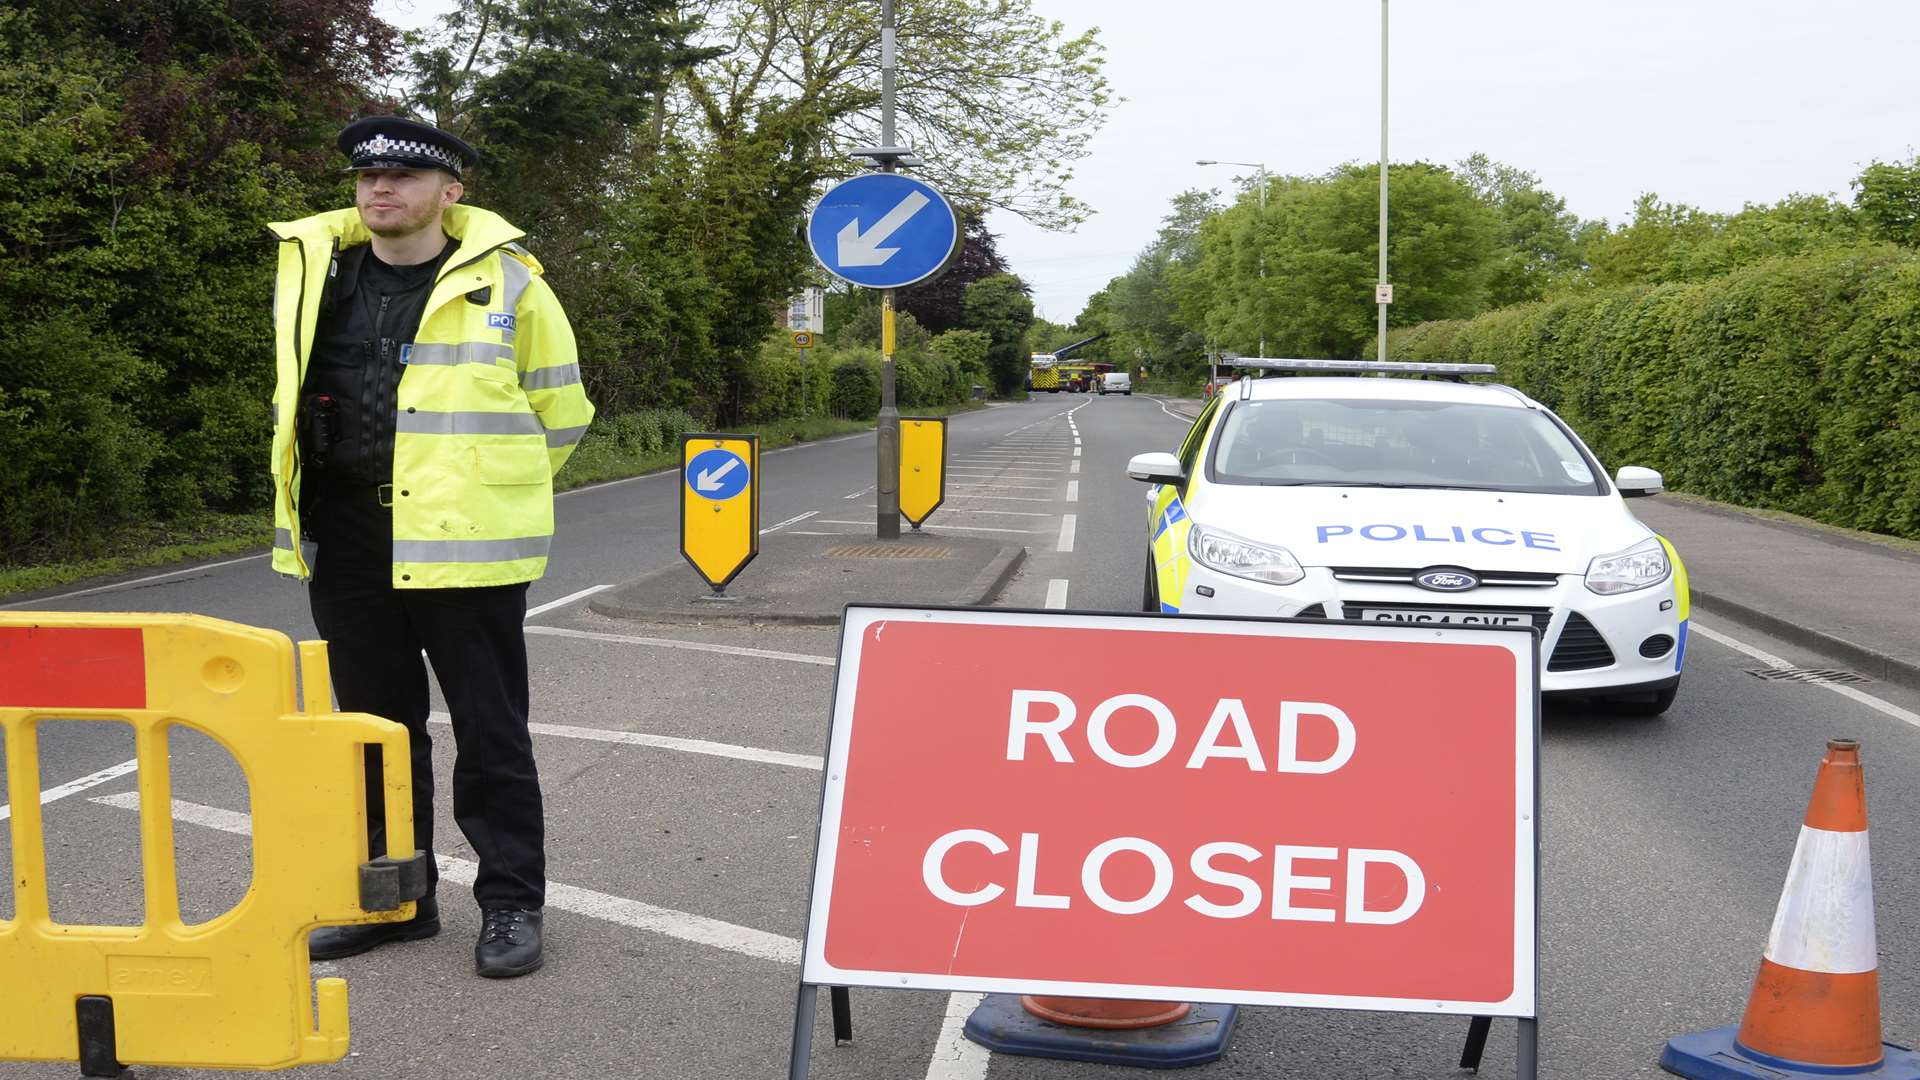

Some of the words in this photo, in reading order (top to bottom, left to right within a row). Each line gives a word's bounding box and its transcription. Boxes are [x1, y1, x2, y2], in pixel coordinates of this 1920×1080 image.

[1316, 524, 1561, 551] POLICE
[1431, 575, 1464, 586] Ford
[1006, 689, 1356, 775] ROAD
[922, 829, 1426, 925] CLOSED
[114, 968, 207, 991] amey
